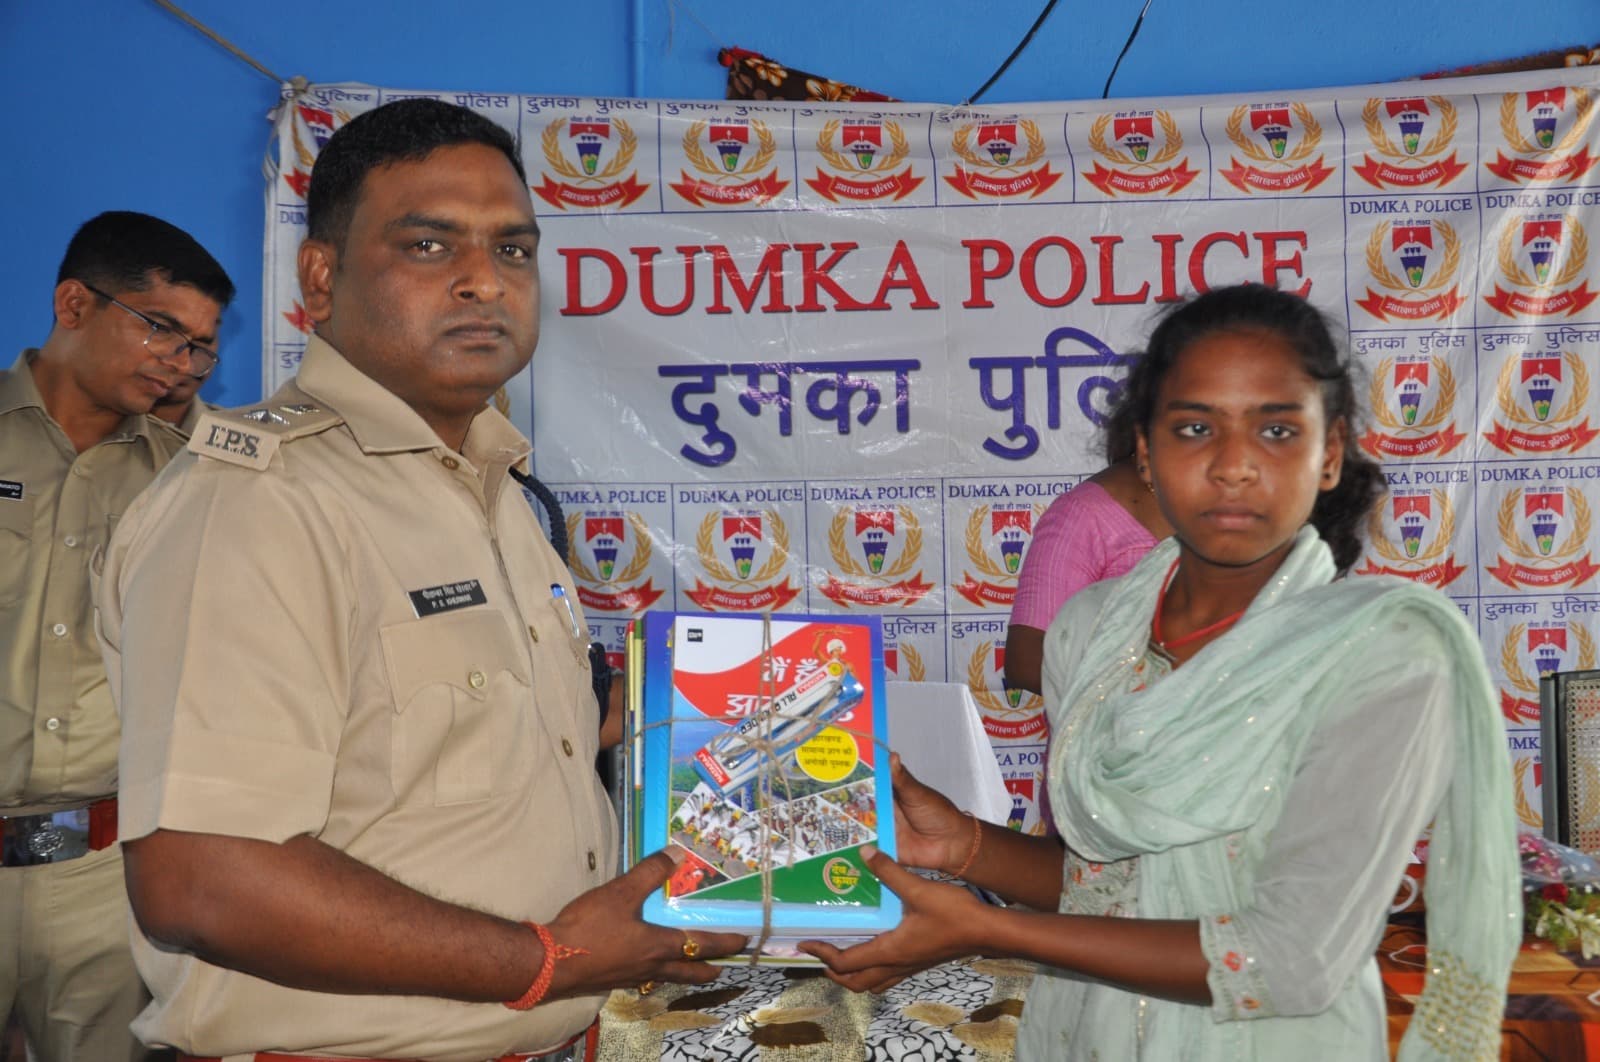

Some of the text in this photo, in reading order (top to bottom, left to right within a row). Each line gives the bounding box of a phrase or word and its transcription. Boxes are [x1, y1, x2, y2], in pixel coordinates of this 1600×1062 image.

[1350, 198, 1473, 214] DUMKA POLICE
[557, 231, 1312, 317] DUMKA POLICE
[1356, 331, 1466, 354] दुमका पुलिस
[1482, 326, 1600, 350] दुमका पुलिस
[658, 326, 1140, 468] दुमका पुलि
[1415, 470, 1468, 484] POLICE
[1481, 468, 1542, 482] DUMKA
[554, 490, 666, 504] UMKA POLICE
[679, 488, 802, 504] DUMKA POLICE
[811, 486, 936, 500] DUMKA POLICE
[948, 483, 1073, 498] DUMKA POLICE
[1485, 602, 1537, 620] दुमका
[883, 617, 937, 640] पुलिस
[952, 620, 1006, 638] दुमका
